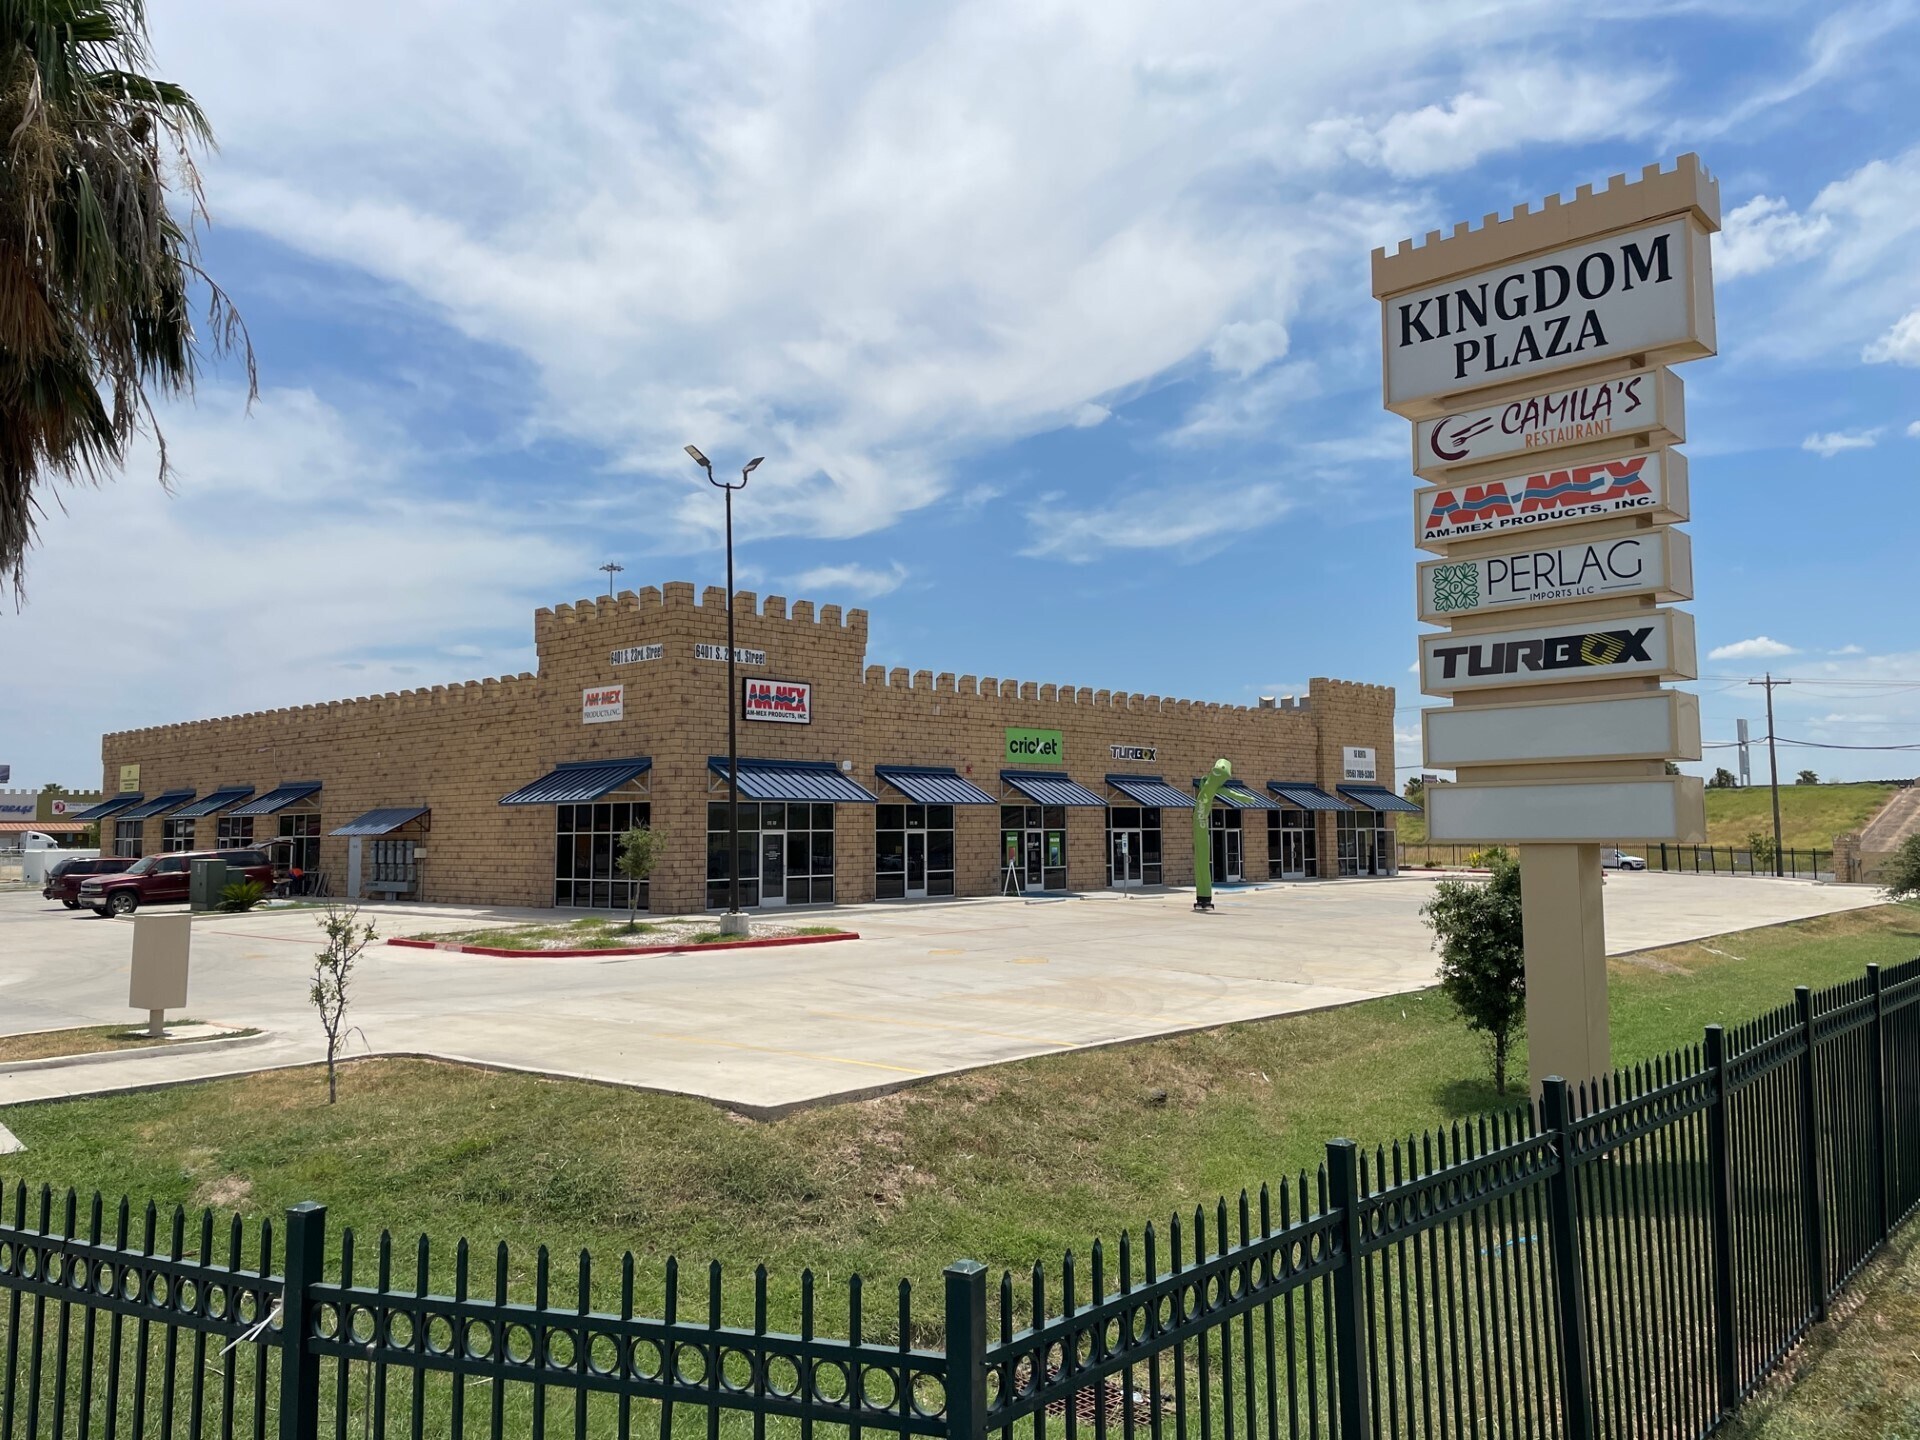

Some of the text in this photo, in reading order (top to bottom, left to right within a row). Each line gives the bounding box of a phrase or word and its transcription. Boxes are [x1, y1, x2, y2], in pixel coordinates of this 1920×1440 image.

[1398, 233, 1673, 348] KINGDOM
[1454, 309, 1609, 379] PLAZA
[1501, 376, 1642, 434] CAMILA'S
[1525, 418, 1612, 449] RESTAURANT
[1424, 496, 1656, 540] AM-MEX PRODUCTS, INC.
[1488, 540, 1642, 595] PERLAG
[1530, 586, 1595, 601] IMPORTS LLC
[646, 645, 662, 659] Street
[696, 644, 765, 665] 6401 S. 2rd. Street
[1433, 627, 1655, 679] TURBOX
[768, 711, 796, 720] PRODUCTS,
[1010, 736, 1057, 755] cricket
